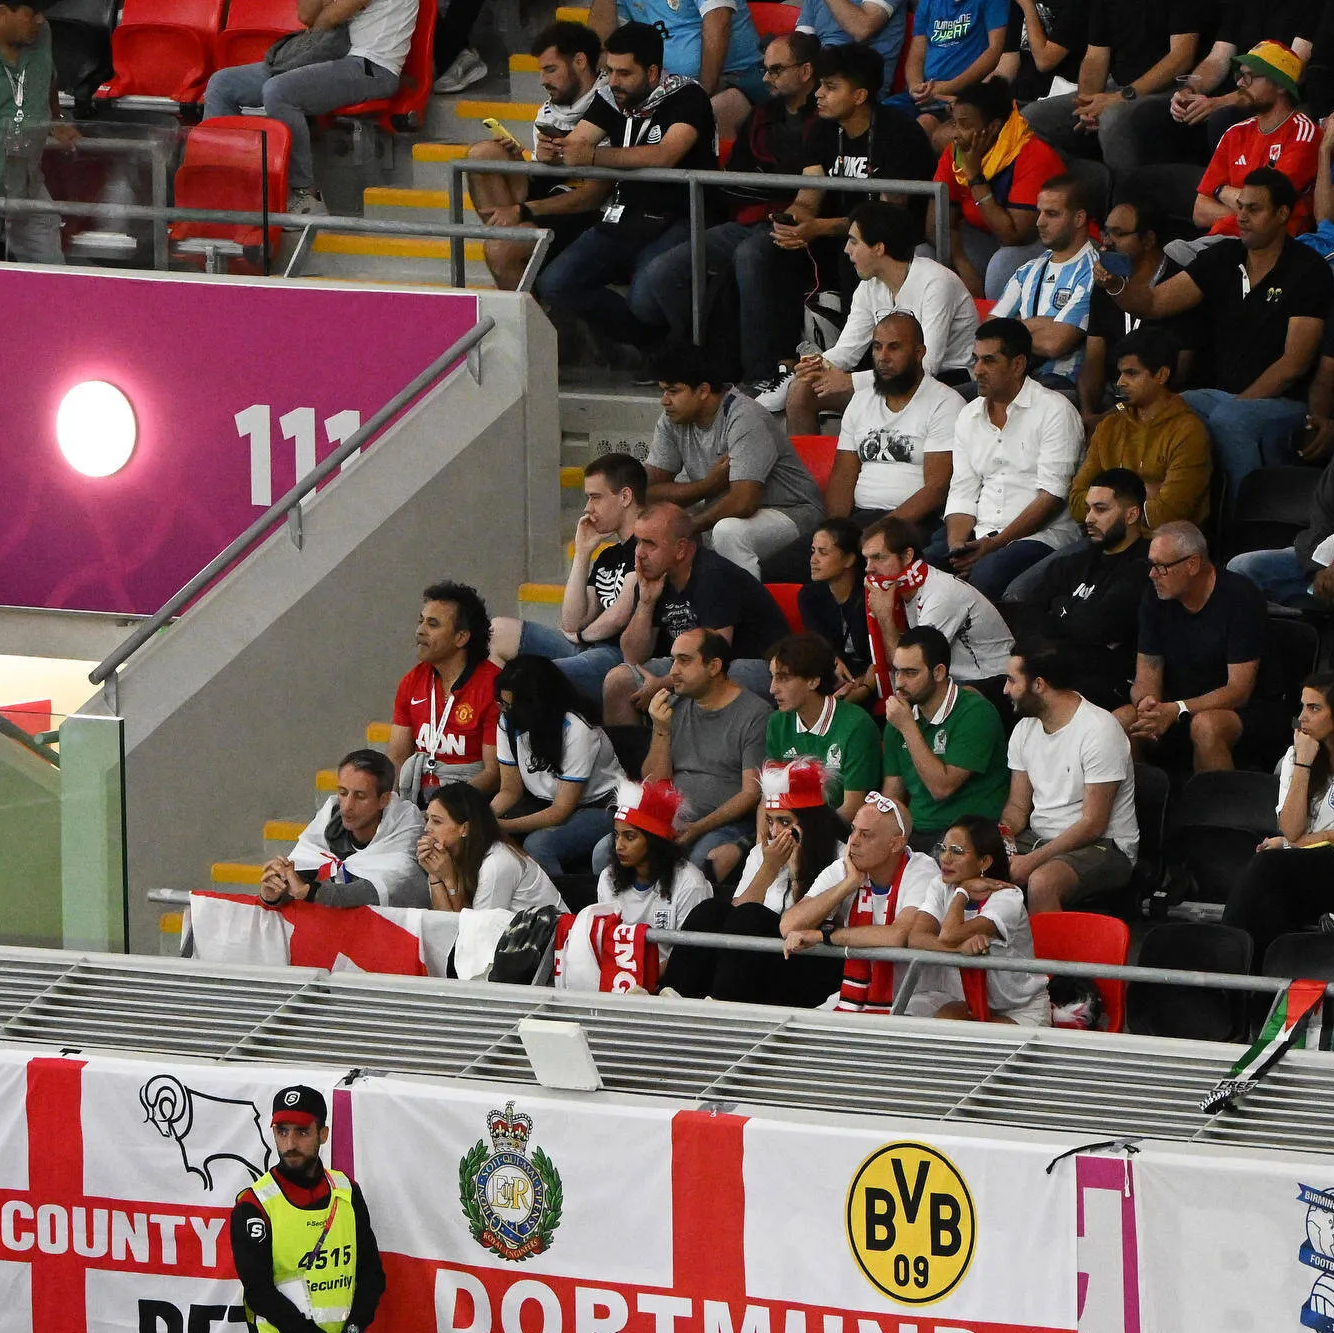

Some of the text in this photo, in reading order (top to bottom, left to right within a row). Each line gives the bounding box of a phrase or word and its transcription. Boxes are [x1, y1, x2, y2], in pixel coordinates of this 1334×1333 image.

[416, 722, 466, 756] AON
[1217, 1079, 1258, 1094] FREE
[864, 1158, 963, 1258] BVB
[0, 1200, 228, 1268] COUNTY
[298, 1245, 351, 1270] 4515
[893, 1254, 930, 1289] 09
